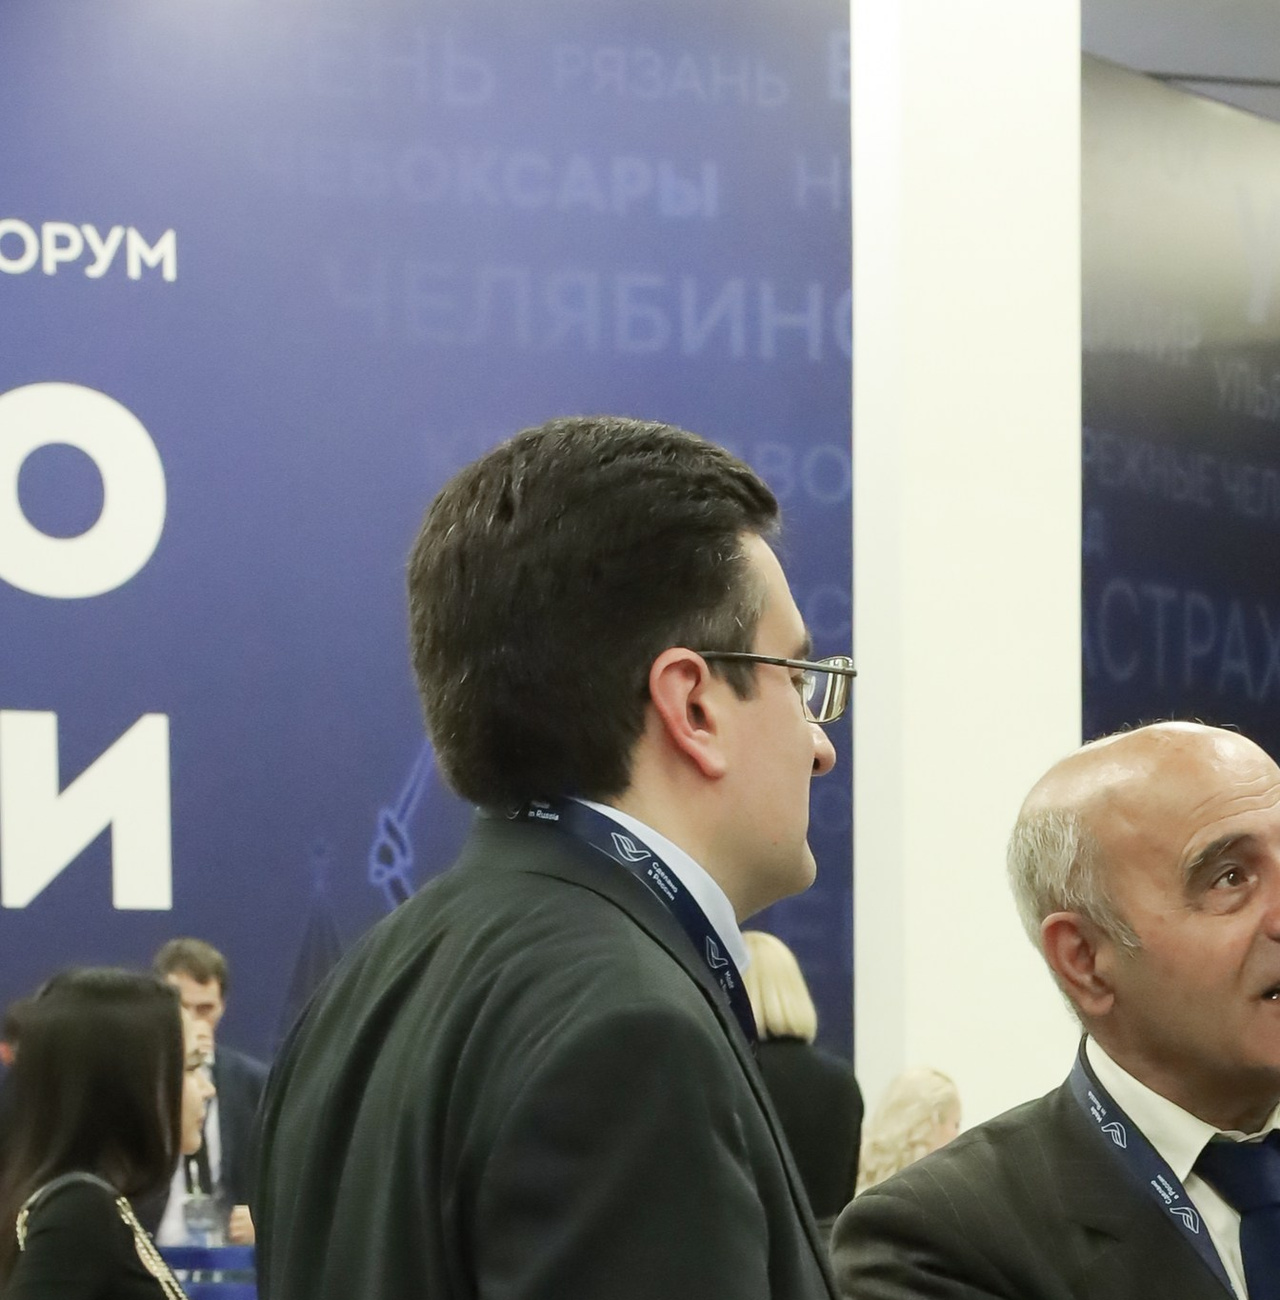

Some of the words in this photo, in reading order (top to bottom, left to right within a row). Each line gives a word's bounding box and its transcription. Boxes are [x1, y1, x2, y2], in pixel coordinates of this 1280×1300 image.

[551, 42, 791, 110] РЯЗАНЬ
[0, 218, 178, 282] ОРУМ
[0, 382, 167, 599] О
[0, 708, 174, 911] И
